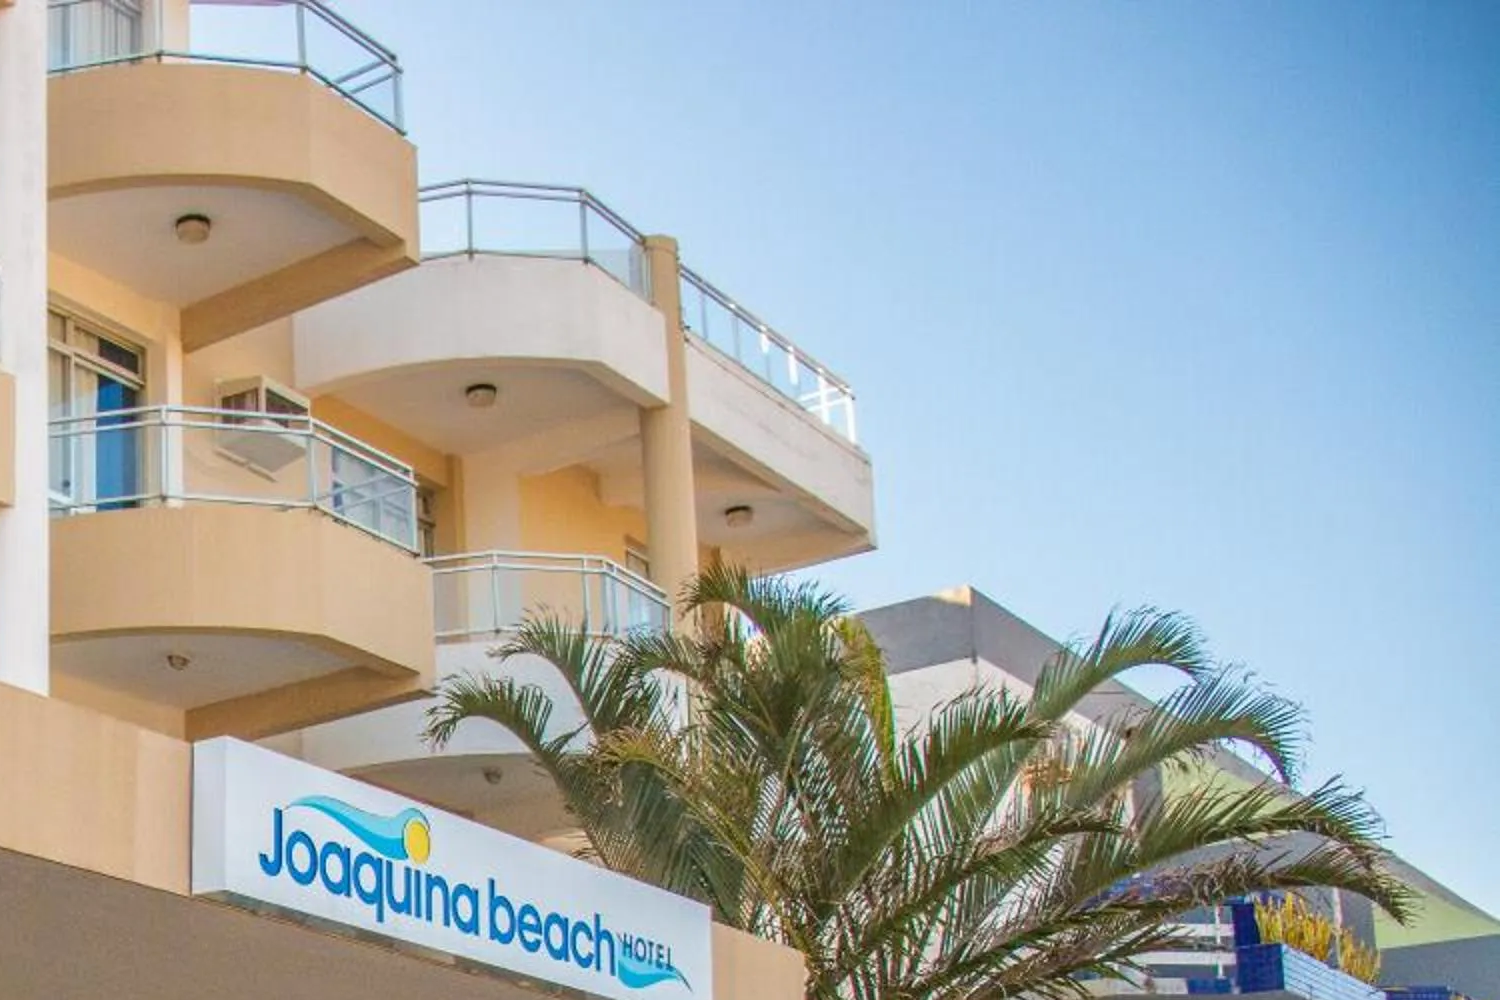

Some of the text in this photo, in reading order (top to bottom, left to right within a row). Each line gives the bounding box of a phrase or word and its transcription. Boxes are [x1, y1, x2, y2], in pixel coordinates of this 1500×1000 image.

[259, 809, 674, 976] Joaquina beach HOTEL
